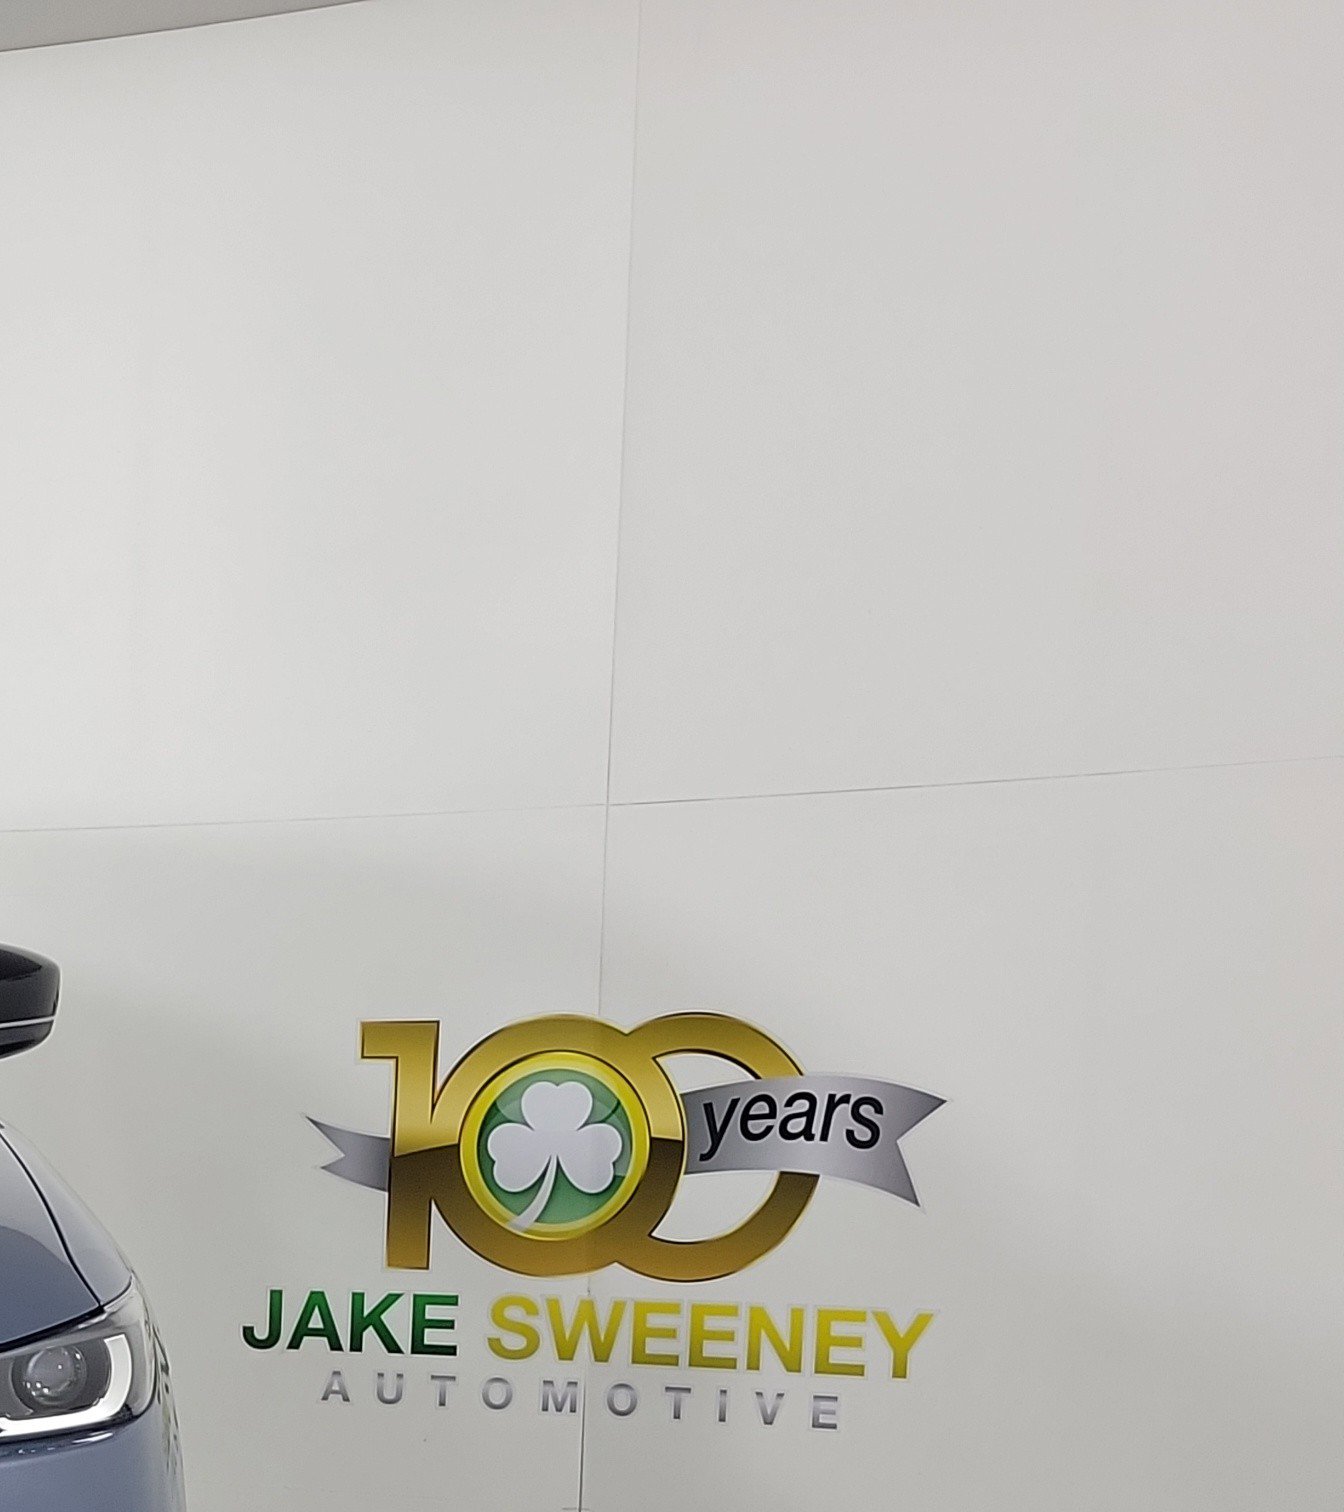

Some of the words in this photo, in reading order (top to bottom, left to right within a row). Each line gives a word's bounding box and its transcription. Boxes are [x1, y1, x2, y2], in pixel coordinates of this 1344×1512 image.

[360, 1010, 821, 1284] 100
[698, 1090, 884, 1162] years
[242, 1289, 459, 1356] JAKE
[486, 1295, 934, 1379] SWEENEY
[320, 1370, 840, 1431] AUTOMOTIVE
